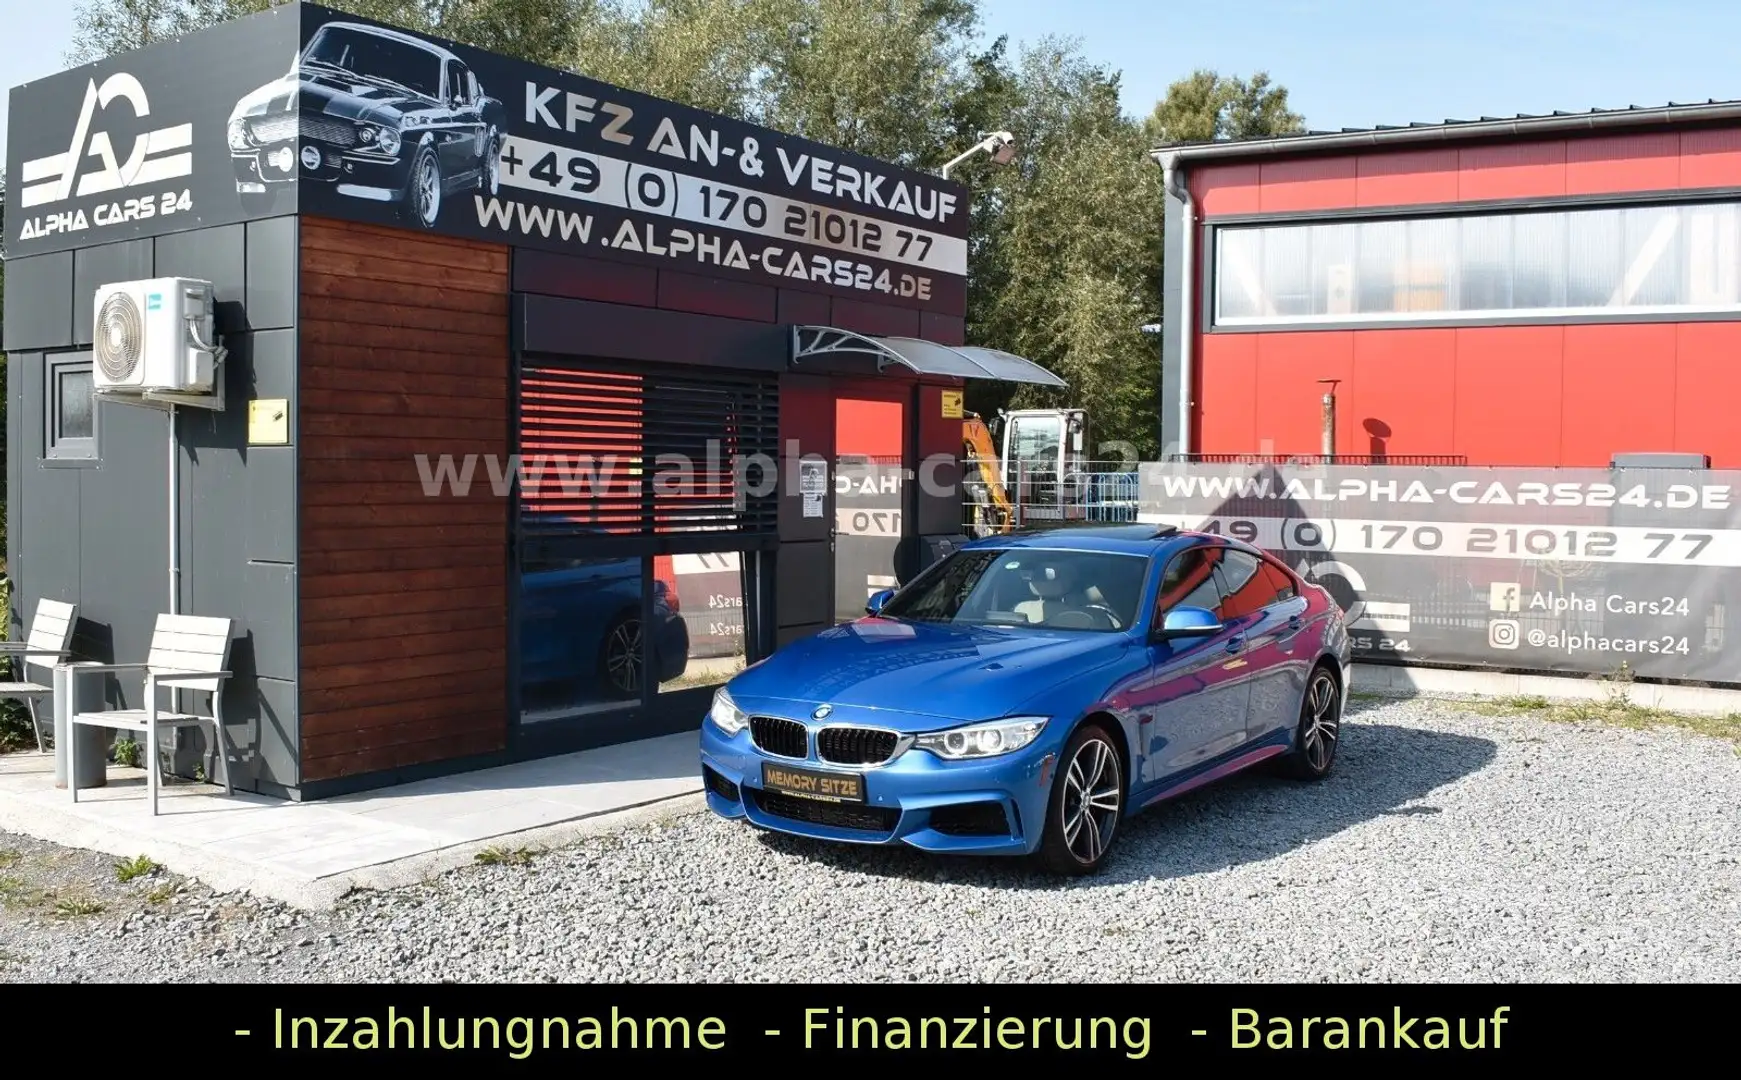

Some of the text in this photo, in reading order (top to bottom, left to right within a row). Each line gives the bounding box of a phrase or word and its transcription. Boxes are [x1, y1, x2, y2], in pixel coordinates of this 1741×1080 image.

[525, 80, 634, 146] KFZ
[775, 146, 957, 223] VERKAUF
[19, 188, 193, 240] ALPHA CARS 24
[501, 145, 933, 262] +49 (0) 170 21012 77
[1163, 475, 1731, 510] WWW.ALPHA-CARS24.DE
[1281, 518, 1336, 551] (0)
[1360, 523, 1443, 551] 170
[1466, 527, 1618, 557] 21012
[1643, 532, 1714, 560] 77
[1529, 591, 1690, 620] Alpha Cars24
[1379, 638, 1410, 652] 24
[1528, 630, 1690, 656] @alphacars24
[767, 769, 858, 796] MEMORY SITZE
